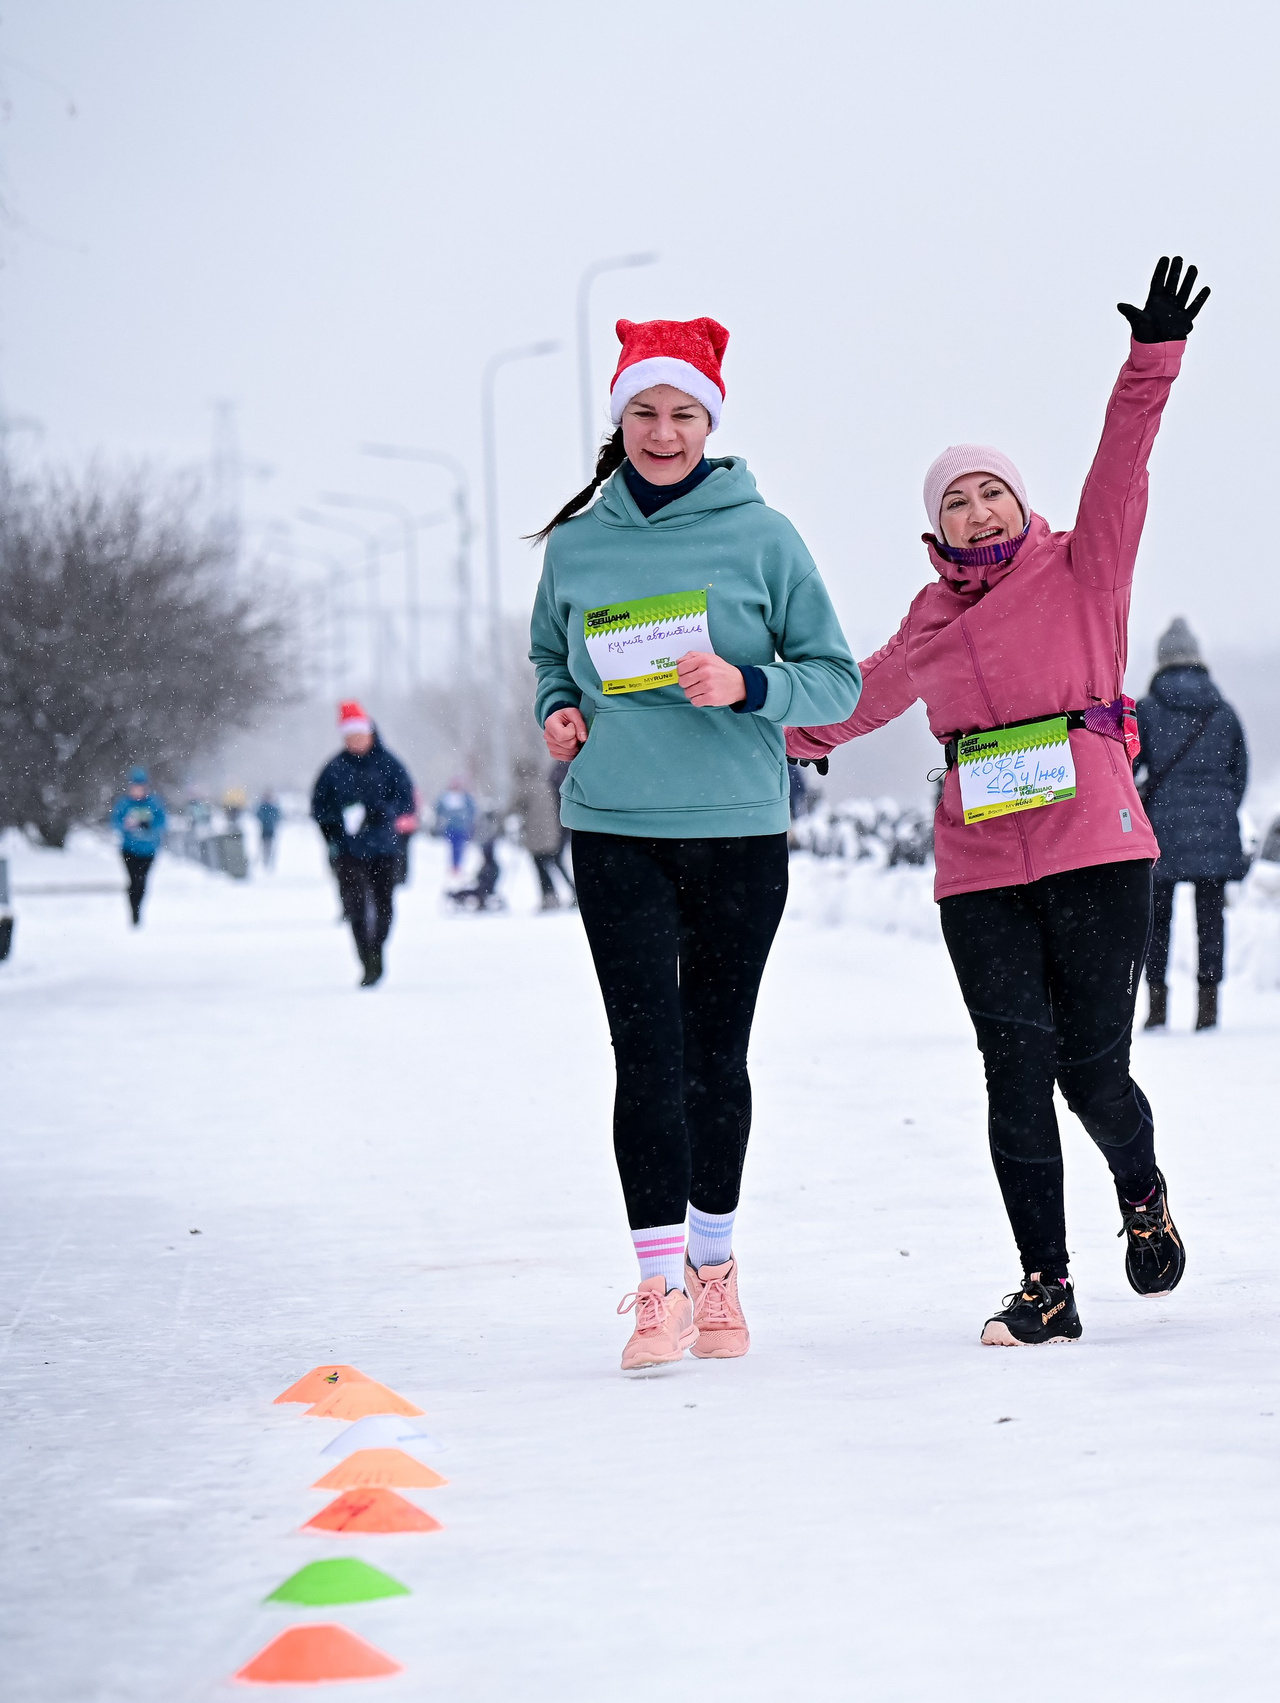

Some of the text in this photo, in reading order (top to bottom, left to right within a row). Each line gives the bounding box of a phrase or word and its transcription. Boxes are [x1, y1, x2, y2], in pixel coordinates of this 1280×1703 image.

[587, 611, 630, 627] ОБЕЩАНИЙ
[655, 656, 671, 666] БЕГУ
[960, 740, 999, 755] ОБЕЩАНИЙ
[970, 755, 1026, 778] КОФЕ
